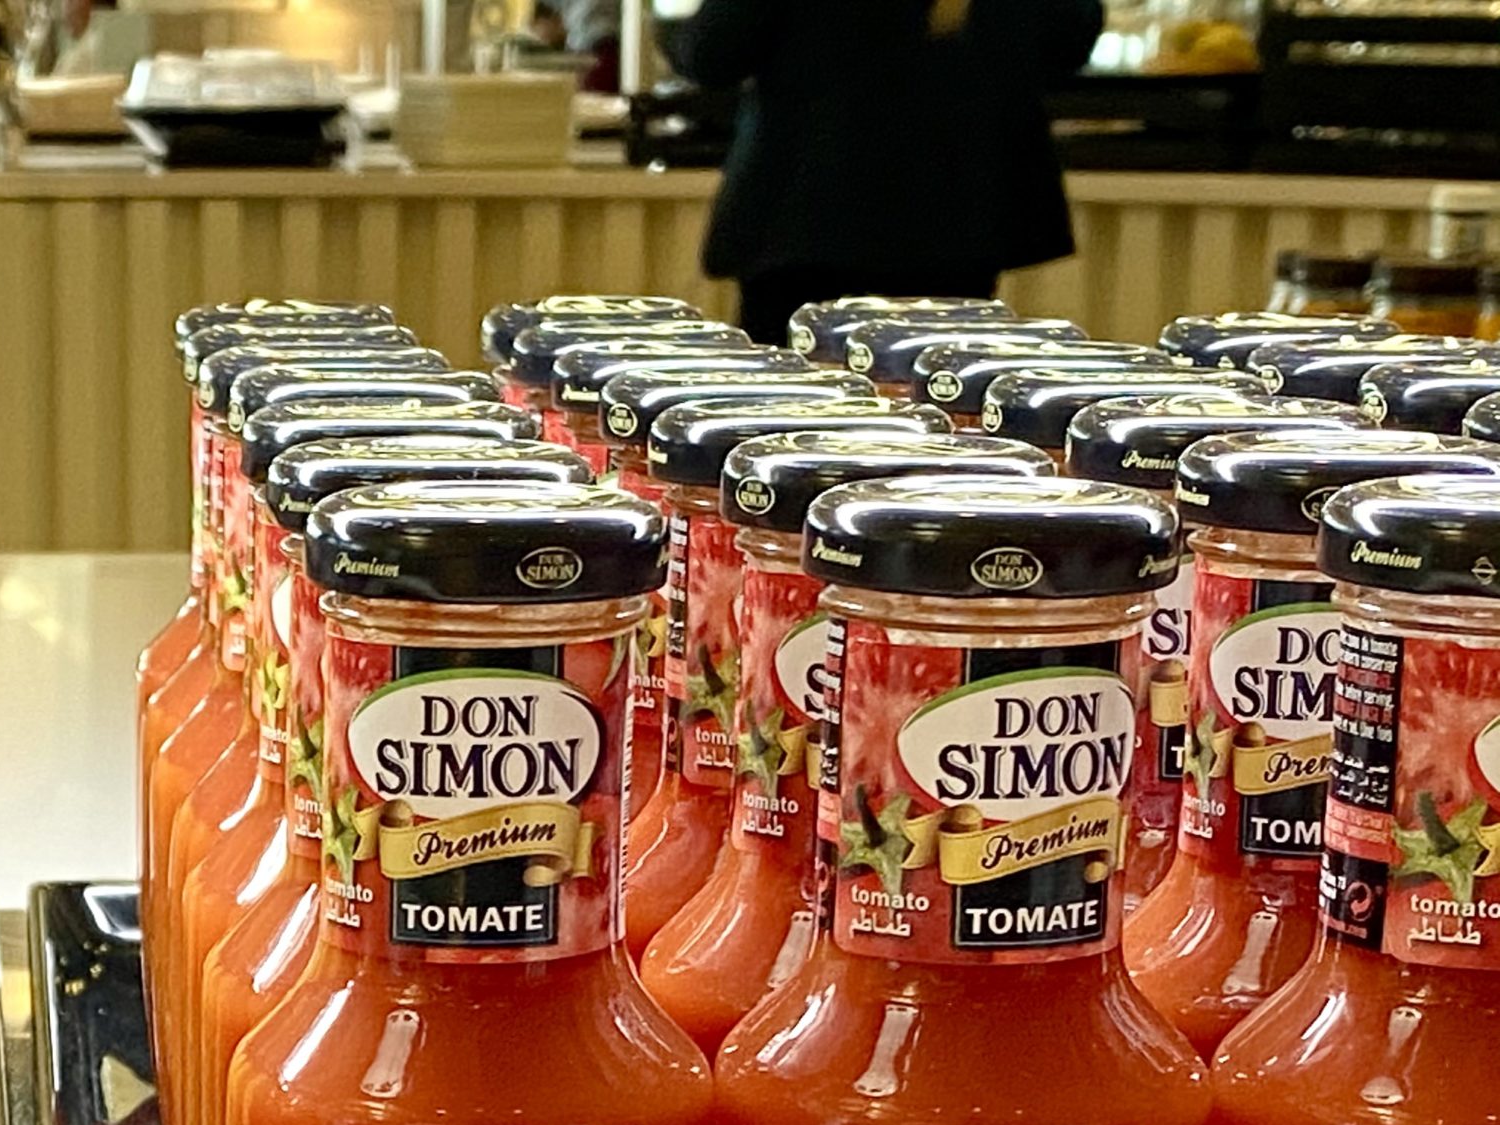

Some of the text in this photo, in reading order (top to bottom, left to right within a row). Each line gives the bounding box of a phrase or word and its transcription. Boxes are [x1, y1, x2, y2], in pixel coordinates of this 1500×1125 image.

[334, 551, 399, 578] Premium
[994, 553, 1024, 567] DON
[1350, 539, 1423, 570] Premium
[525, 563, 575, 582] SIMON
[980, 564, 1035, 584] SIMON
[1276, 626, 1340, 667] DO
[1232, 666, 1334, 722] SIM
[419, 694, 539, 738] DON
[994, 690, 1102, 740] DON
[374, 737, 584, 799] SIMON
[935, 732, 1128, 802] SIMON
[742, 789, 800, 815] tomato
[412, 816, 558, 866] Premium
[980, 814, 1111, 870] Premium
[1251, 815, 1322, 847] TOM
[850, 884, 931, 913] tomato
[1410, 892, 1500, 919] tomato
[401, 903, 545, 933] TOMATE
[964, 899, 1099, 936] TOMATE
